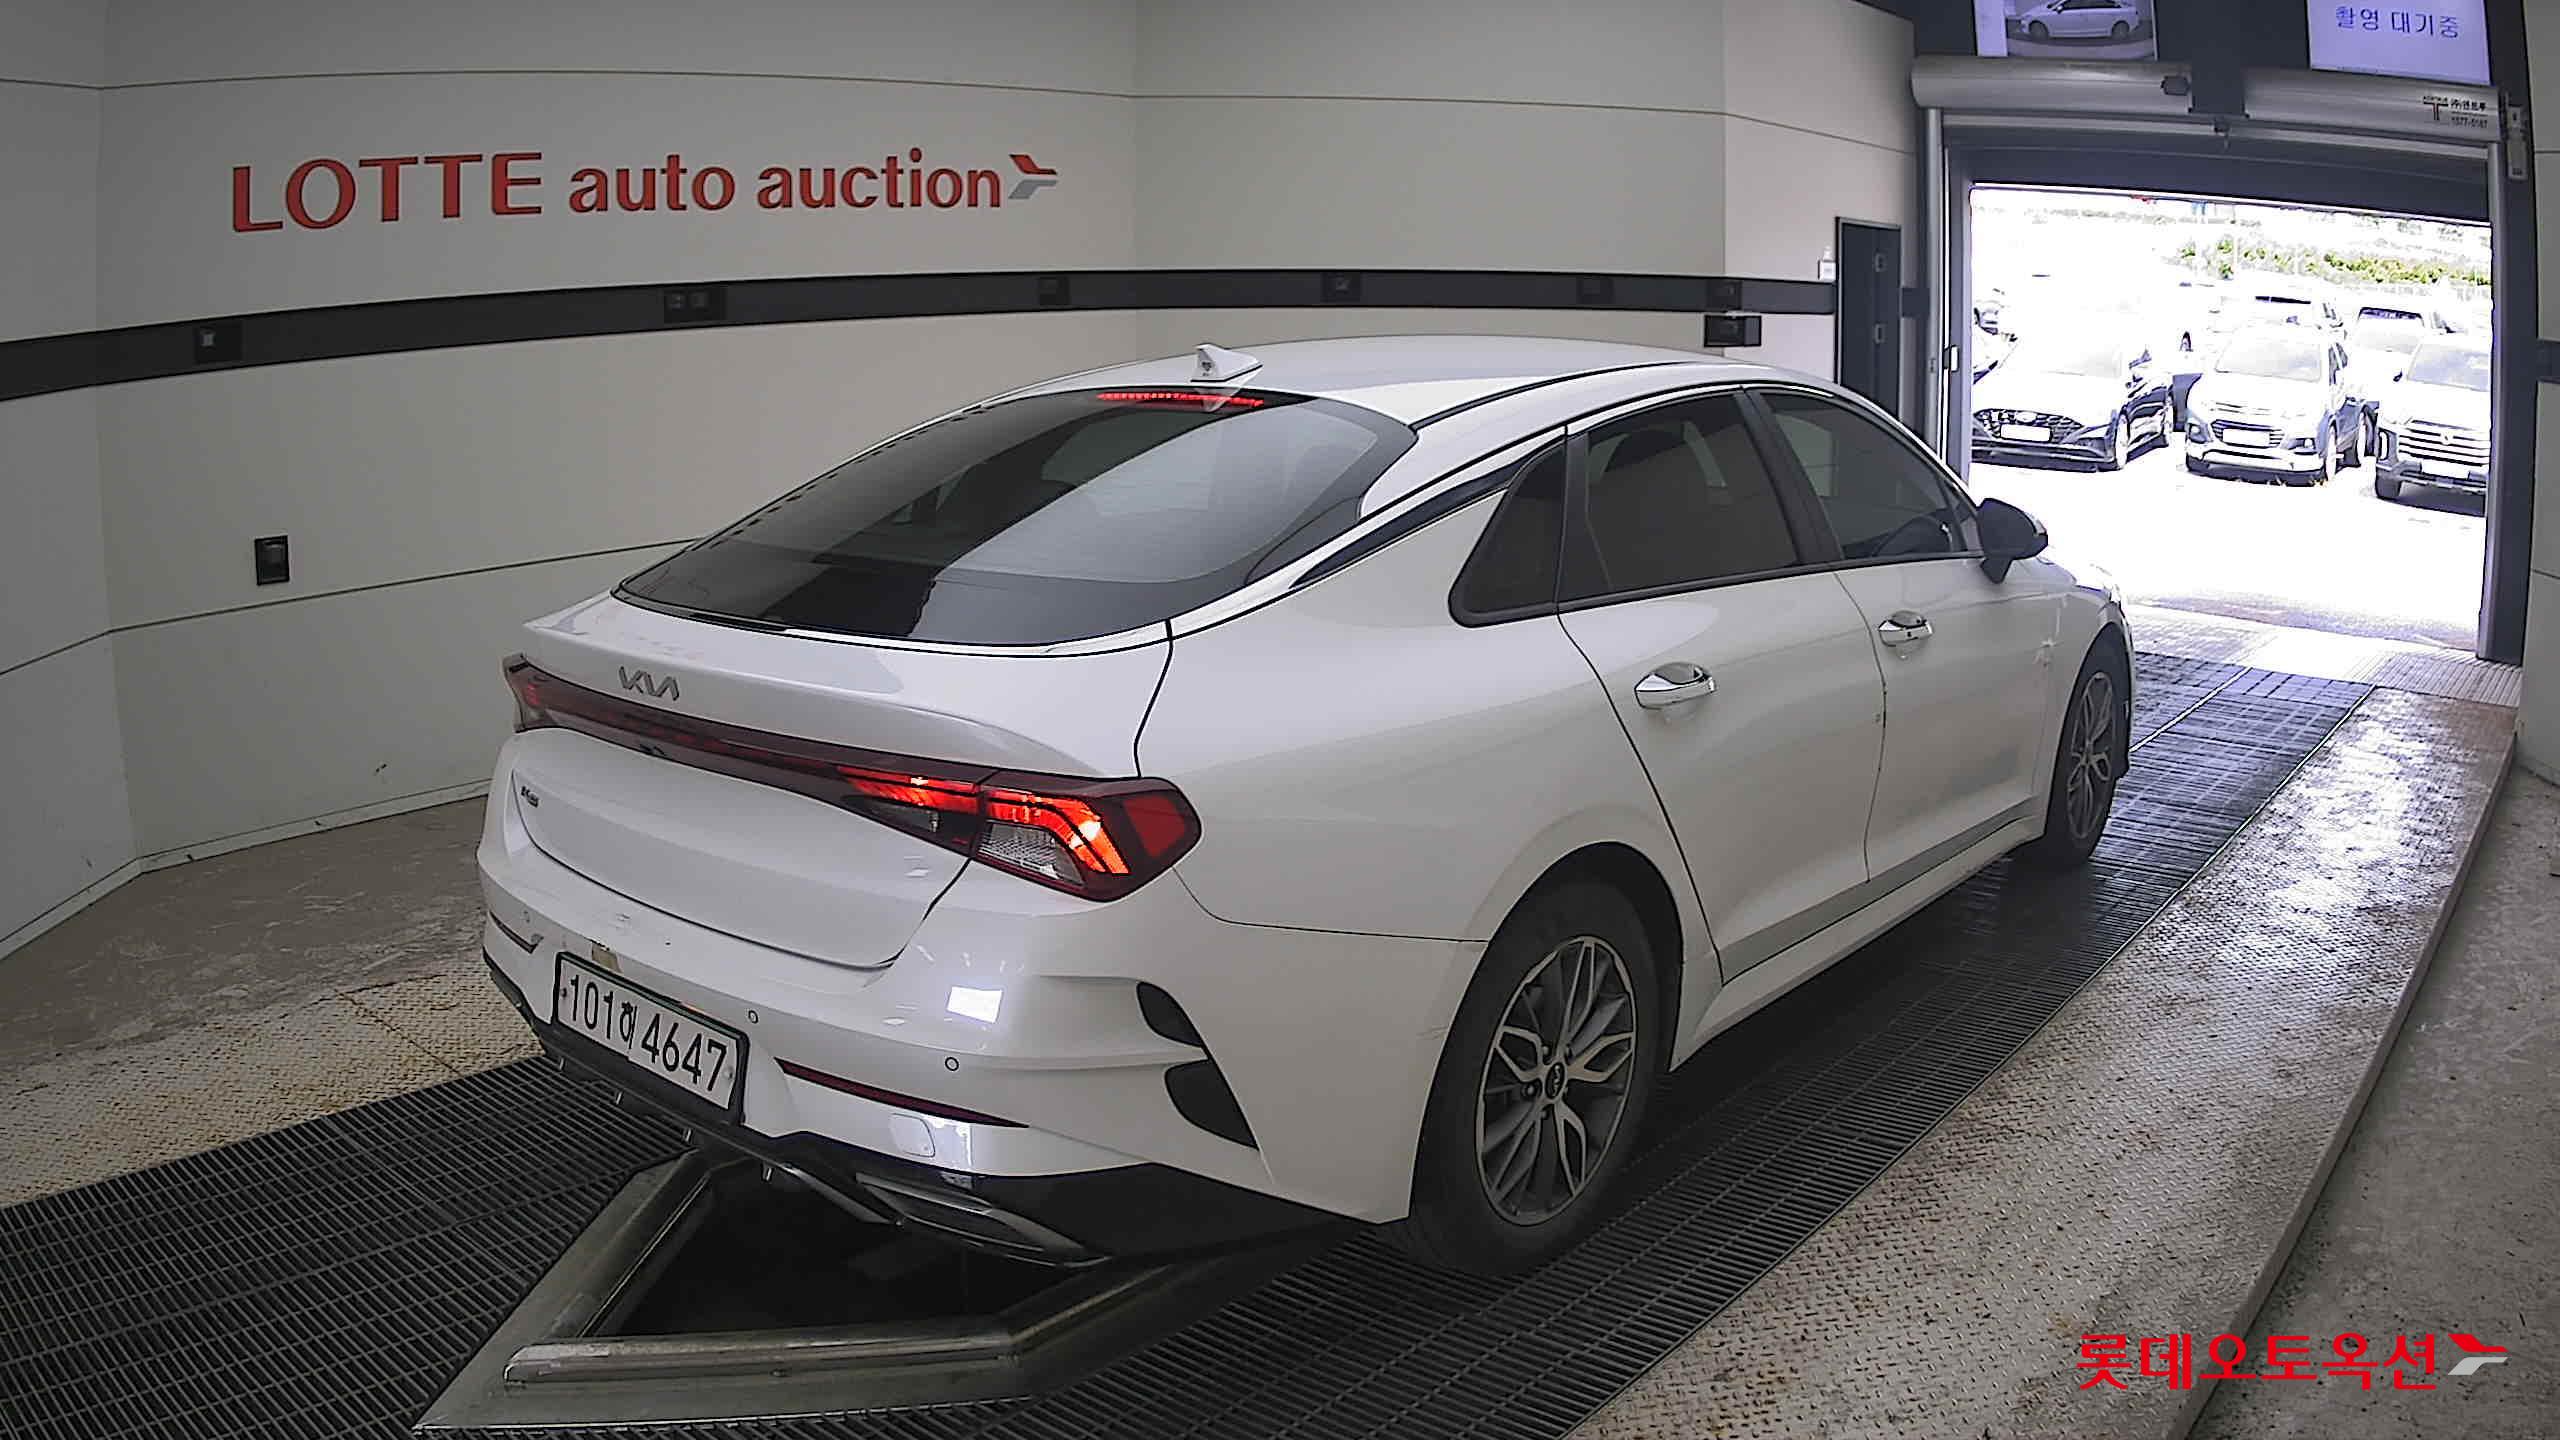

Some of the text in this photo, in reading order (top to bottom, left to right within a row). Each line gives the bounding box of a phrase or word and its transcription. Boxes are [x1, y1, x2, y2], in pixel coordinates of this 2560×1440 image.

[2335, 5, 2459, 39] 촬영 대기중
[232, 147, 1002, 233] LOTTE auto auction
[618, 665, 681, 702] KIA
[640, 1012, 729, 1092] 4647
